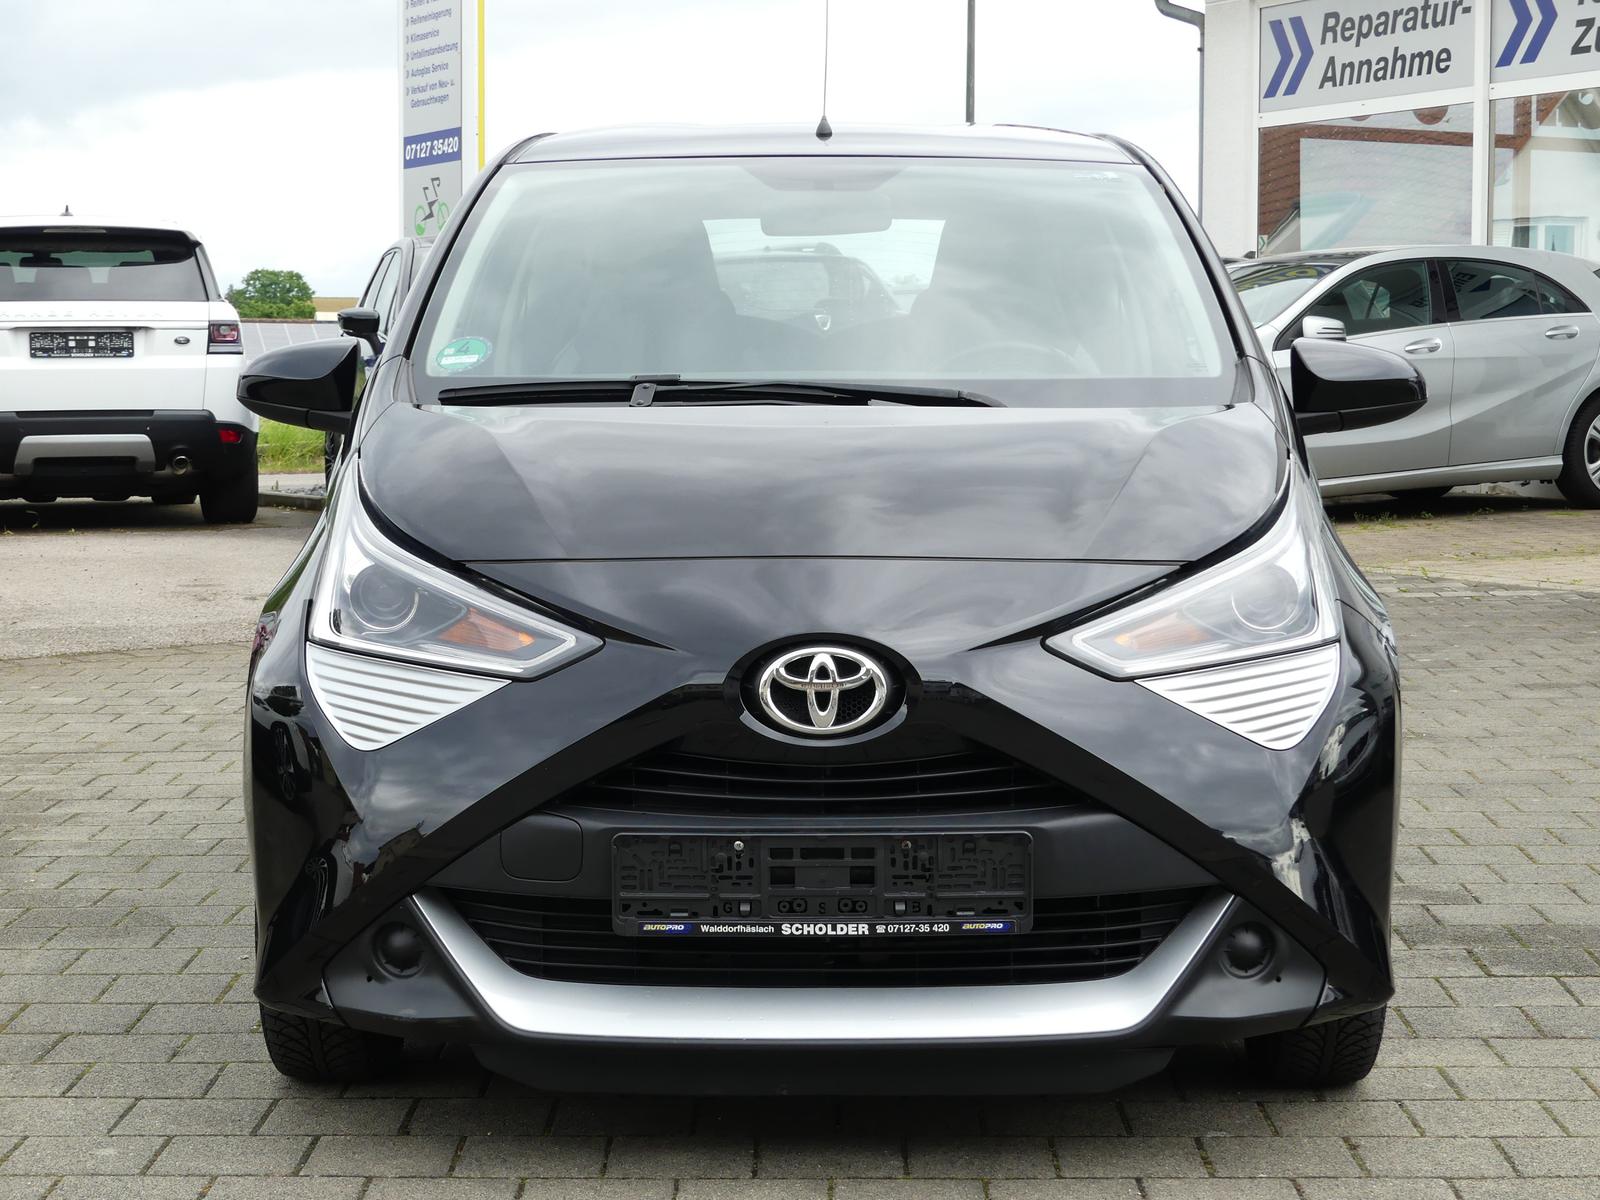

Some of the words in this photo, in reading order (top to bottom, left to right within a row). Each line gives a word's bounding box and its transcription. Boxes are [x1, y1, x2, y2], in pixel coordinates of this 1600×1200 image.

[1320, 0, 1472, 47] Reparatur-
[431, 62, 449, 73] Service
[1318, 46, 1451, 89] Annahme
[405, 141, 432, 160] 07127
[432, 136, 459, 156] 35420
[700, 924, 775, 933] Walddorfhäslach
[781, 923, 869, 935] SCHOLDER
[887, 924, 930, 933] 07127-35
[932, 923, 950, 933] 420
